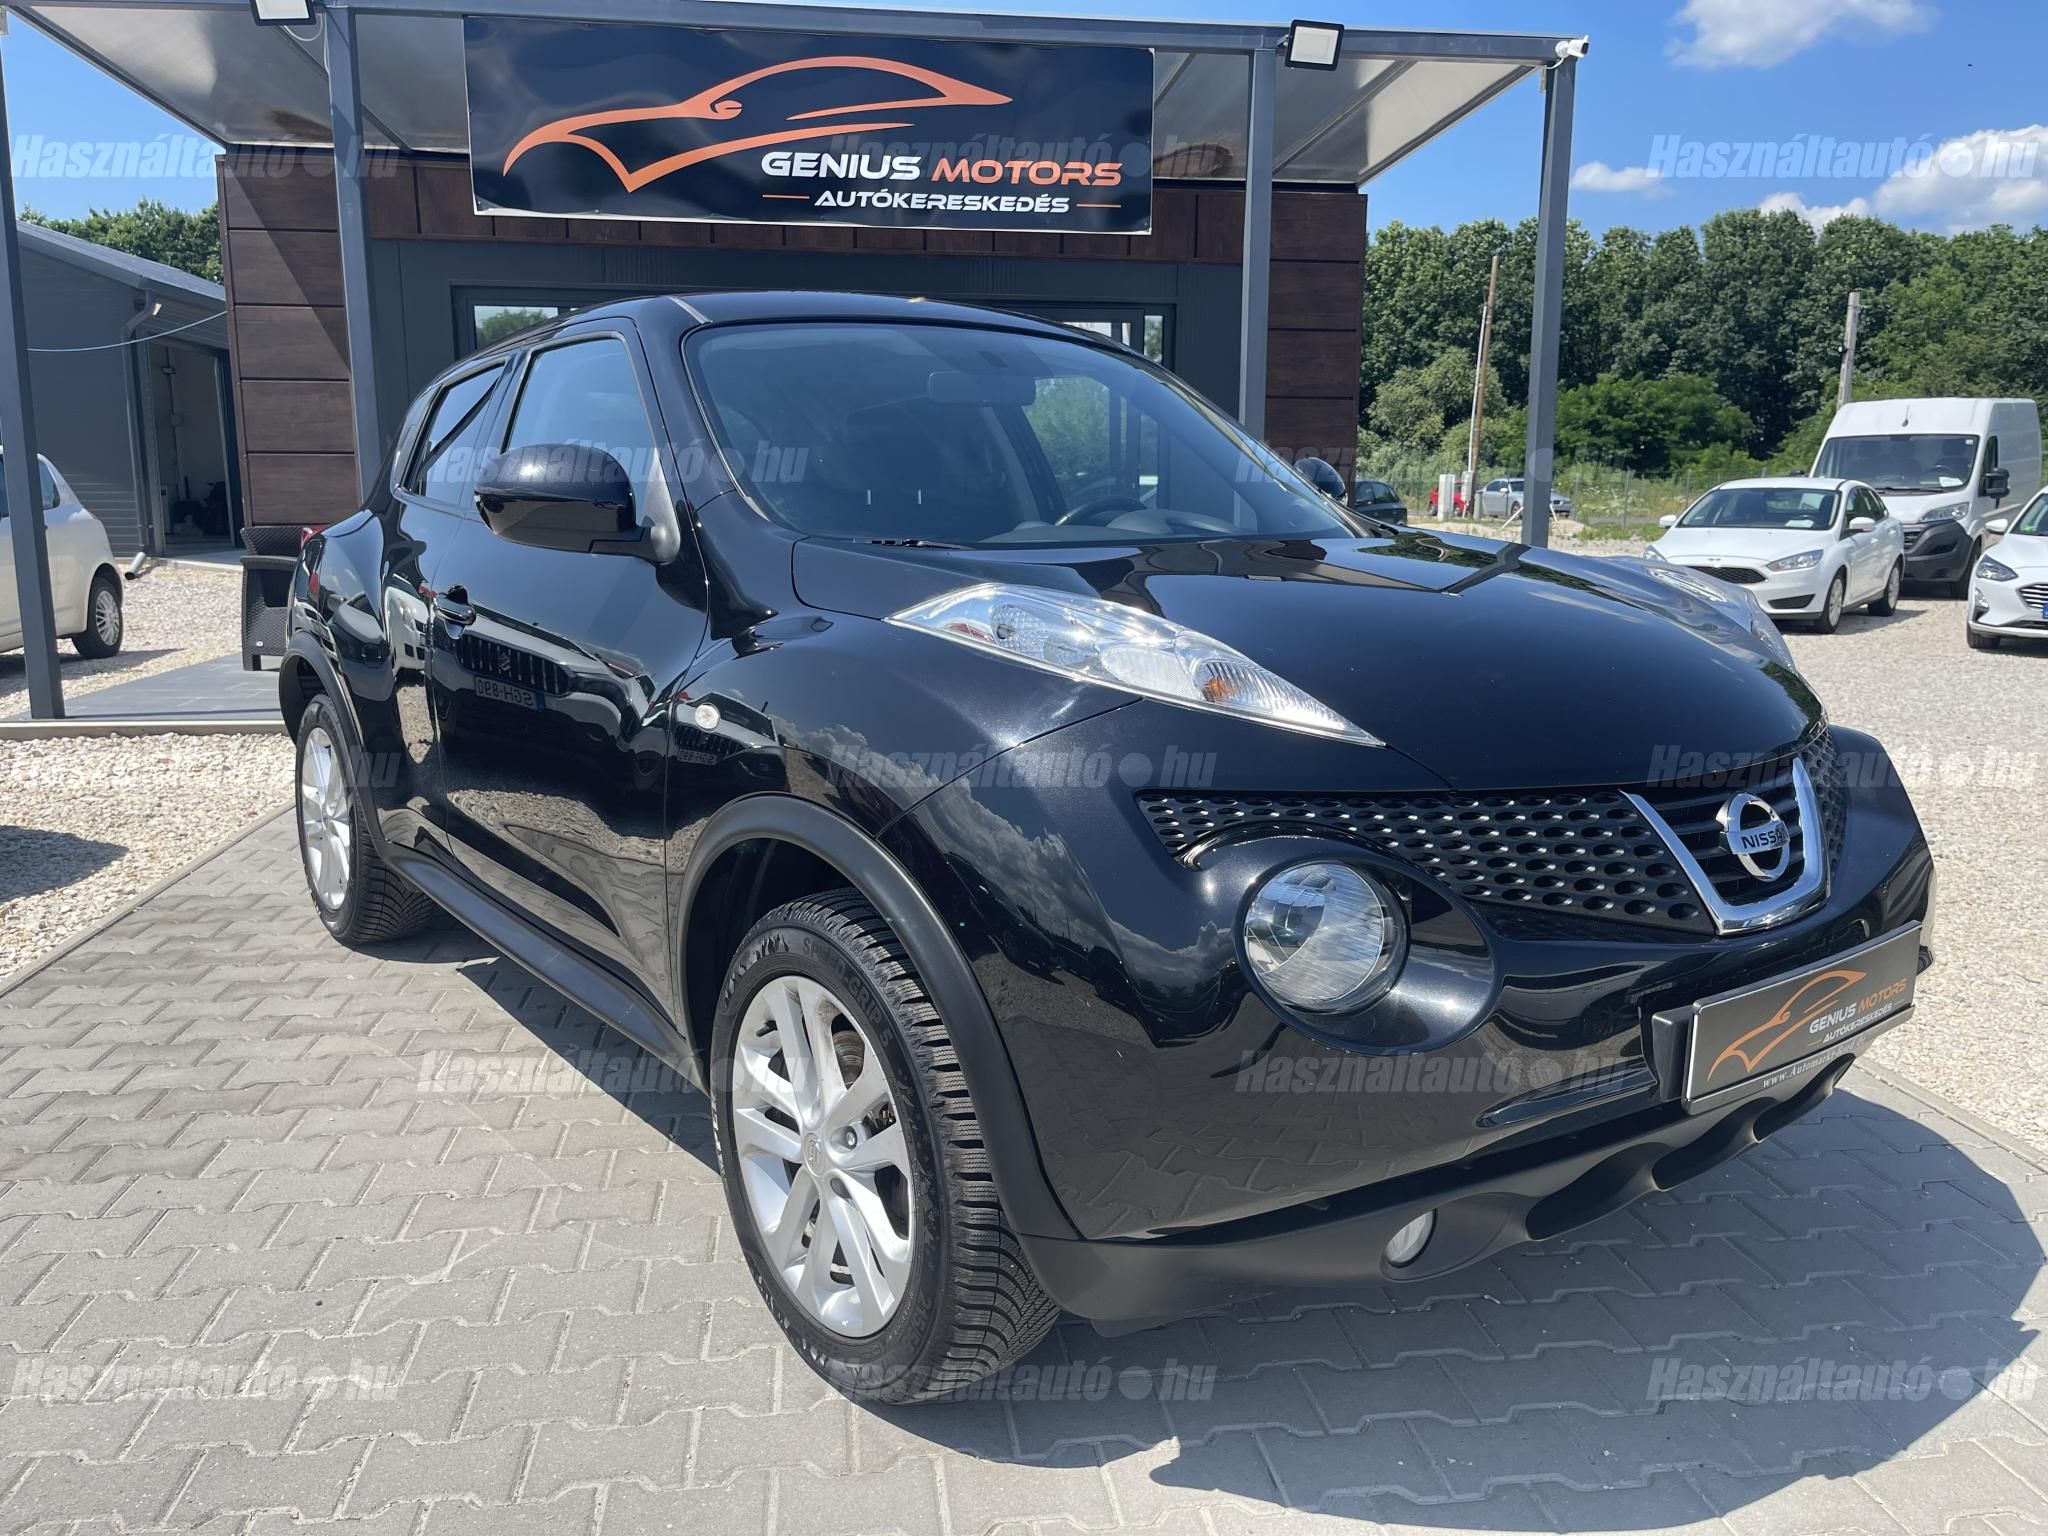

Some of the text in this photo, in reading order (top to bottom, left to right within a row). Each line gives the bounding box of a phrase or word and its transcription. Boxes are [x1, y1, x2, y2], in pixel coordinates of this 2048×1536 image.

[761, 151, 1123, 187] GENIUS MOTORS
[814, 187, 1070, 213] AUTÓKERESKEDÉS
[1809, 977, 1908, 1034] GENIUS MOTORS
